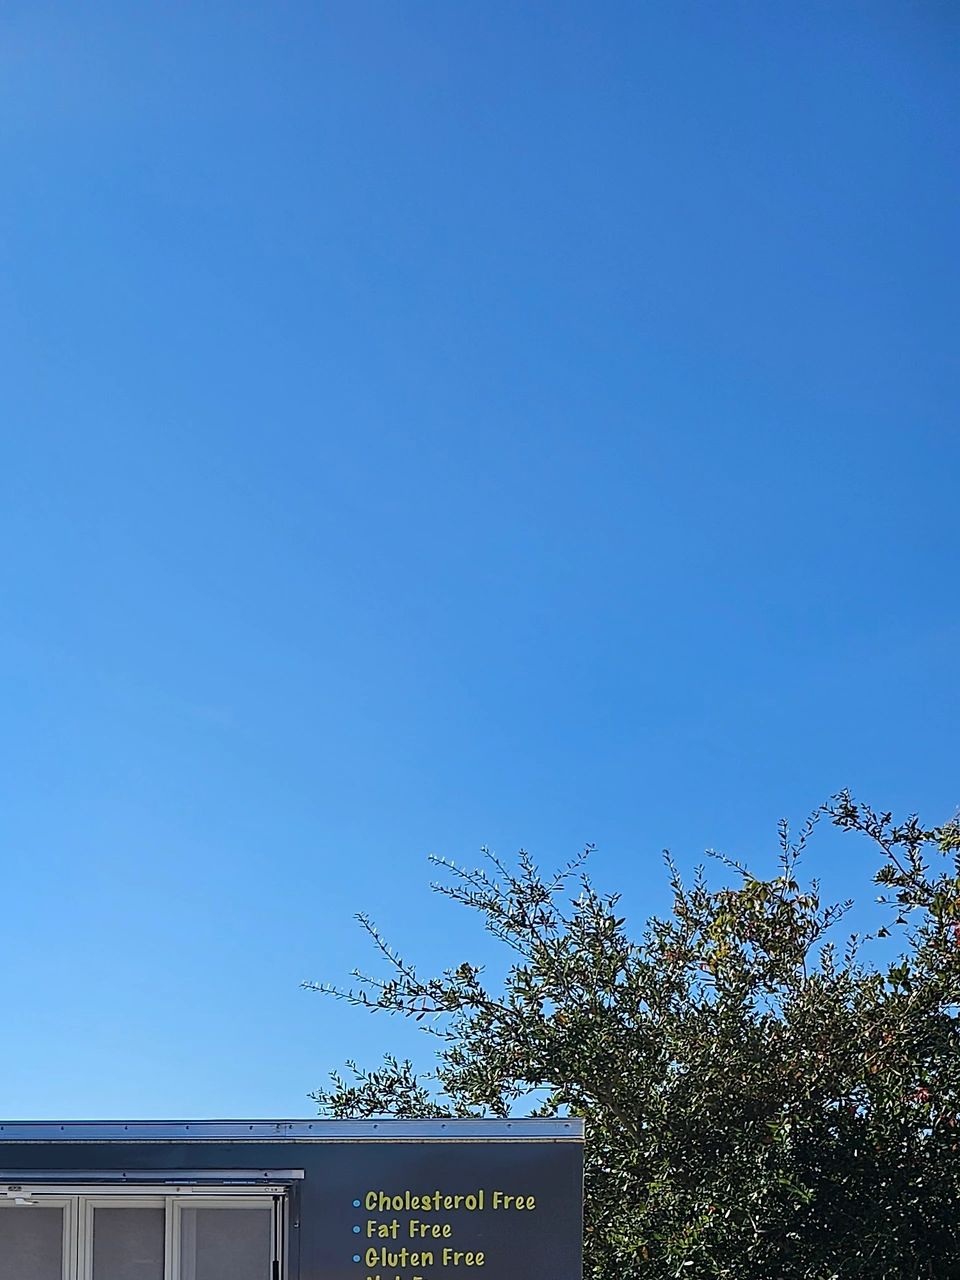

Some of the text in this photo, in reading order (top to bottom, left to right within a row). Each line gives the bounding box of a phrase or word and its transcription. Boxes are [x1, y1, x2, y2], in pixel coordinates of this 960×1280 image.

[364, 1189, 537, 1212] Cholesterol Free
[366, 1219, 453, 1240] Fat Free
[364, 1247, 486, 1268] Gluten Free
